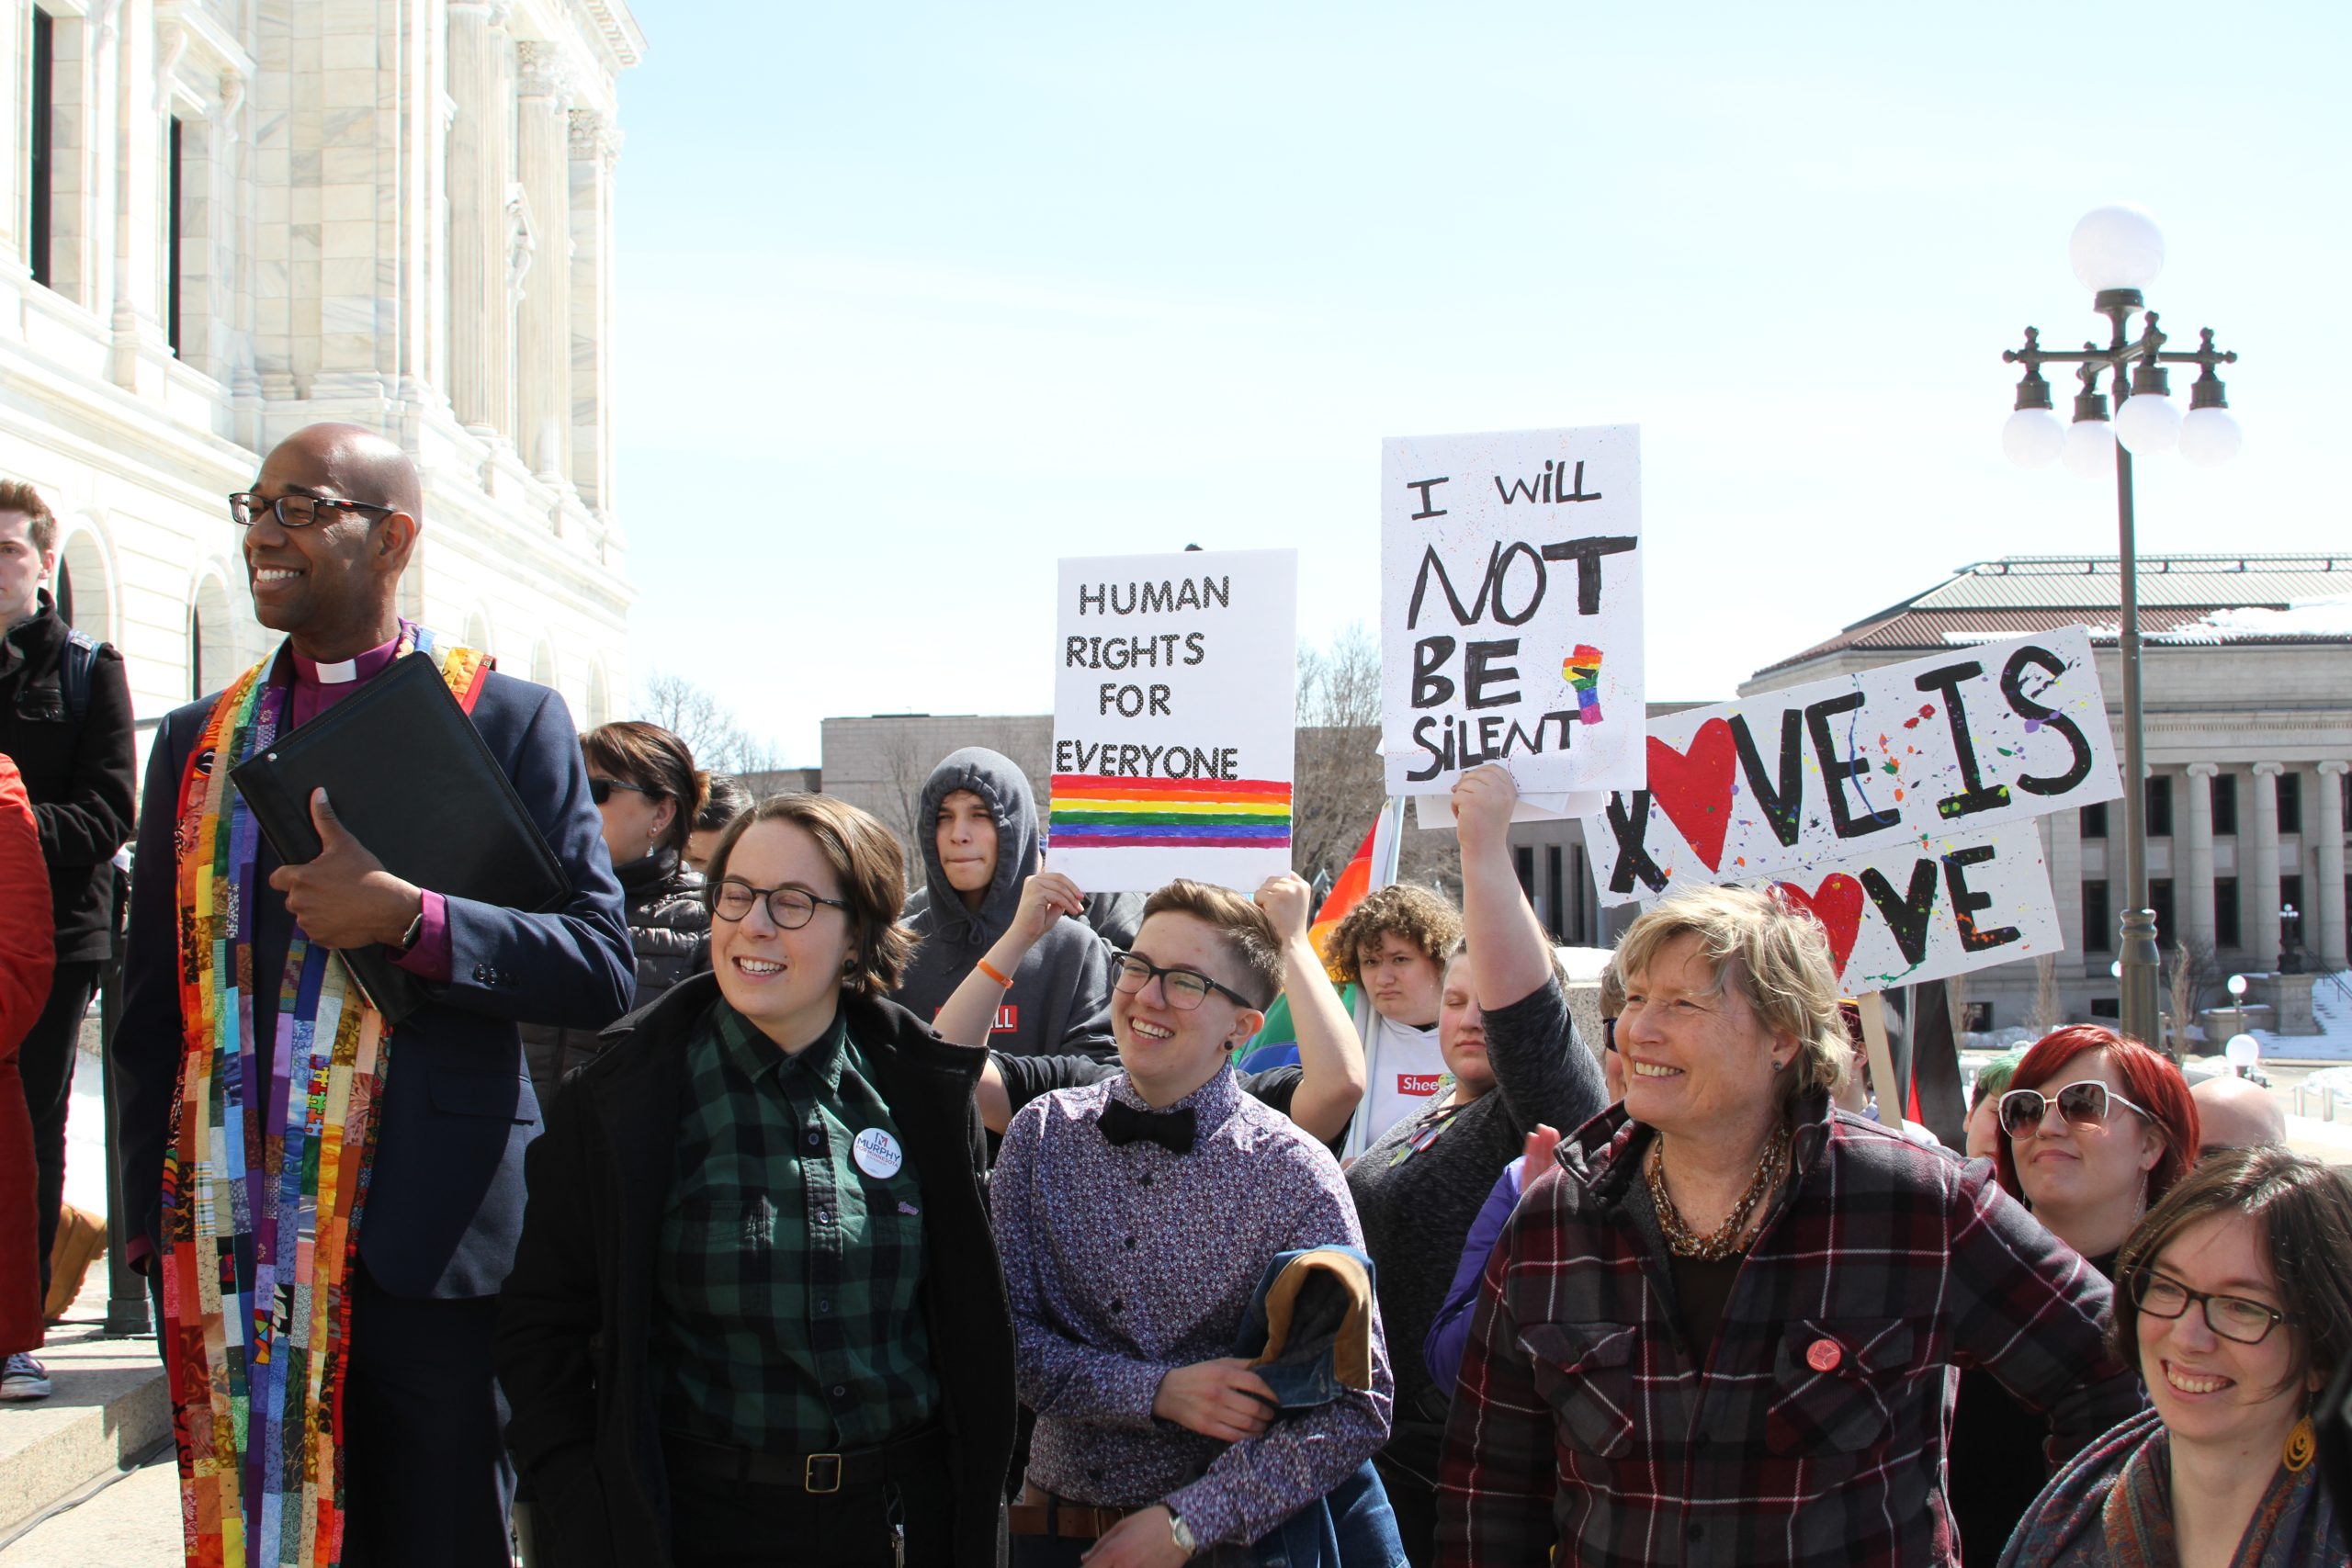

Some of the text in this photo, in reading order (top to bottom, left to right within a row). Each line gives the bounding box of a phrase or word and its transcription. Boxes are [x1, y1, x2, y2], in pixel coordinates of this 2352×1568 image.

[1407, 477, 1450, 520] I
[1079, 575, 1230, 616] HUMAN
[1408, 536, 1638, 630] NOT
[1066, 632, 1205, 671] RIGHTS
[1410, 635, 1521, 710] BE
[1099, 682, 1171, 717] FOR
[1915, 646, 2093, 820] IS
[1056, 739, 1238, 781] EVERYONE
[1403, 1077, 1439, 1091] Shee
[856, 1137, 901, 1162] MURPHY
[867, 1149, 899, 1168] MINNESOTA
